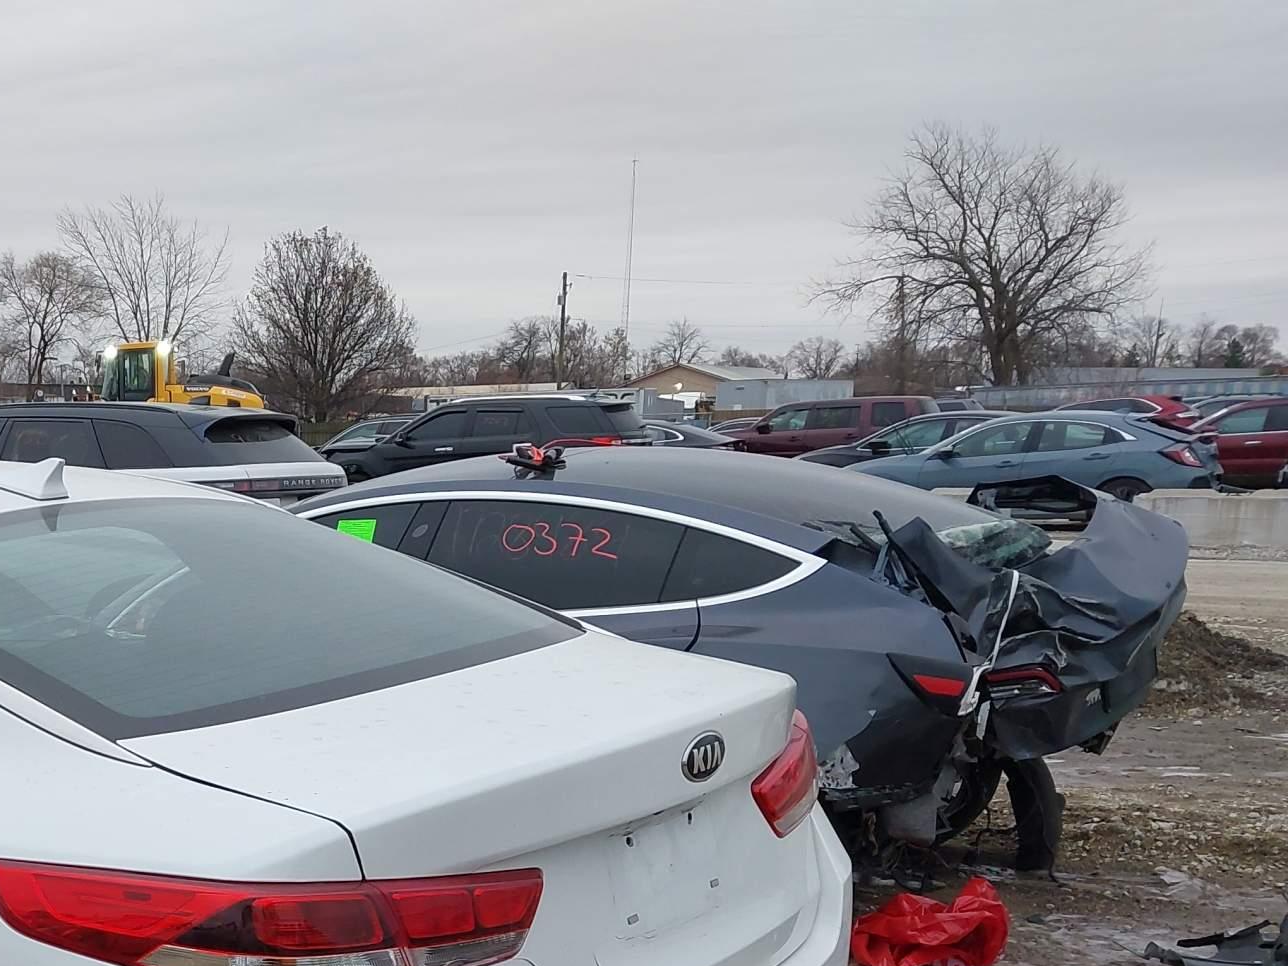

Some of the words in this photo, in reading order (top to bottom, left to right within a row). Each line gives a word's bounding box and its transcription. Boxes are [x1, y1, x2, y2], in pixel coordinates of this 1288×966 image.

[283, 479, 316, 487] RANGE
[502, 522, 618, 559] 0372
[692, 741, 722, 774] KIA
